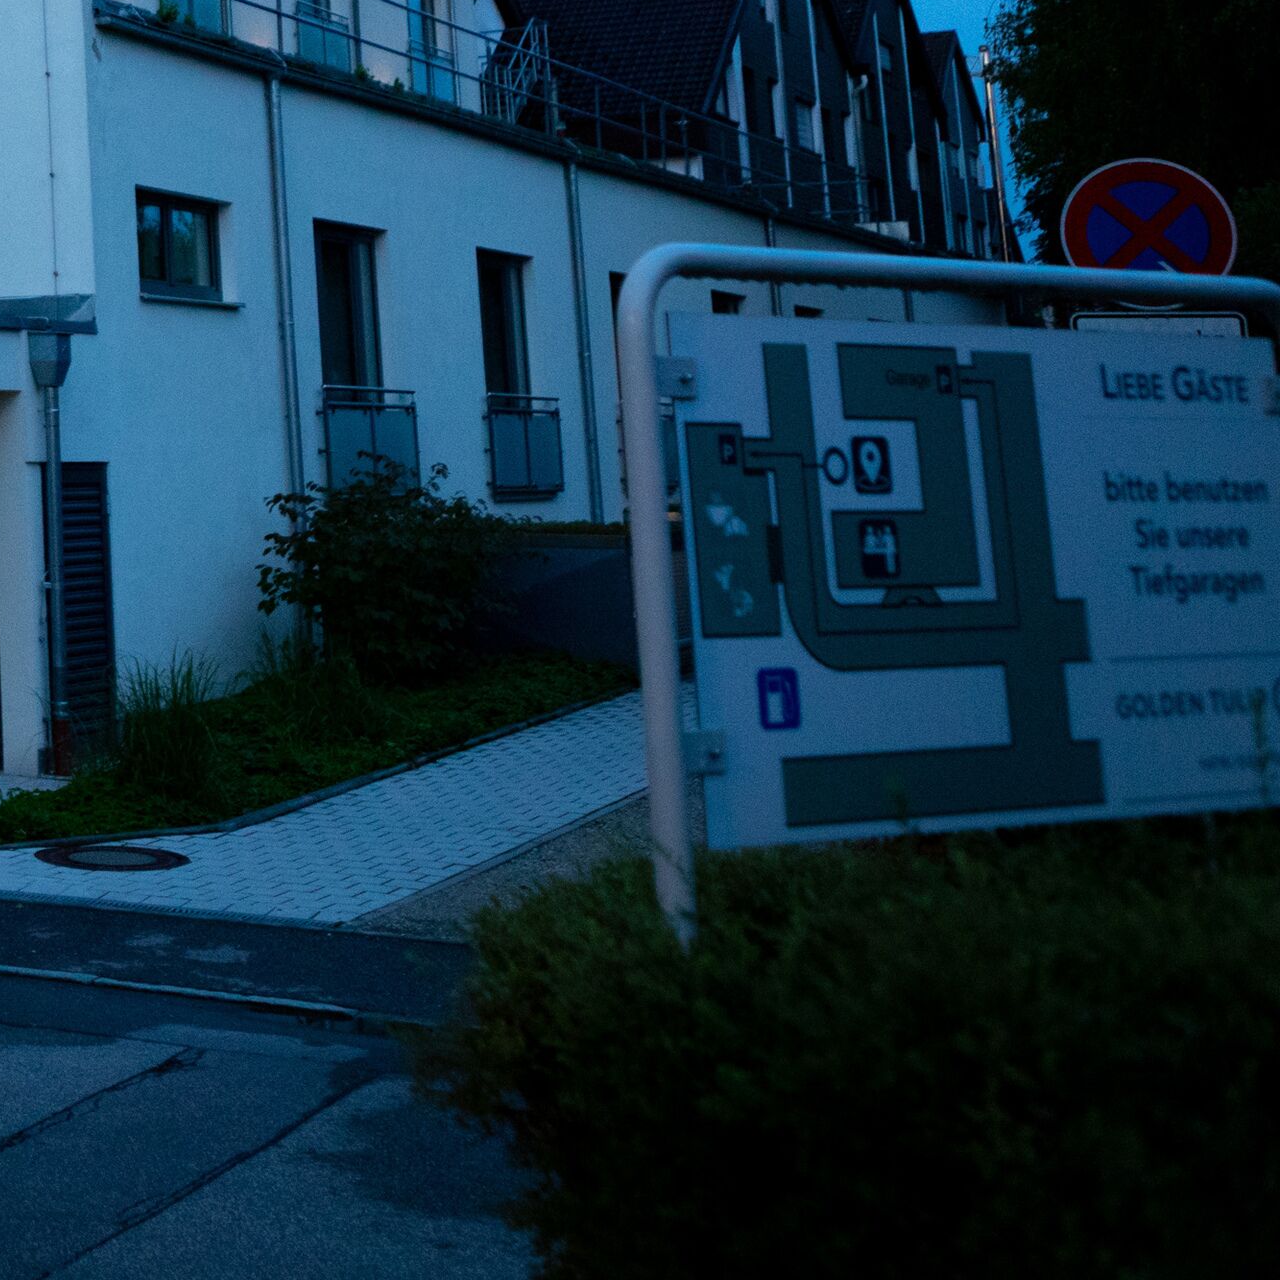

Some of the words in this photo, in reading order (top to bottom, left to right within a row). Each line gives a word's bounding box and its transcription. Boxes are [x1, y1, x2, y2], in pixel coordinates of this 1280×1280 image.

[1100, 363, 1166, 401] LIEBE
[1171, 364, 1250, 403] GÄSTE
[1103, 470, 1159, 503] bitte
[1164, 470, 1269, 503] benutzen
[1134, 519, 1170, 549] Sie
[1175, 525, 1250, 549] unsere
[1129, 564, 1267, 605] Tiefgaragen
[1115, 691, 1205, 720] GOLDEN
